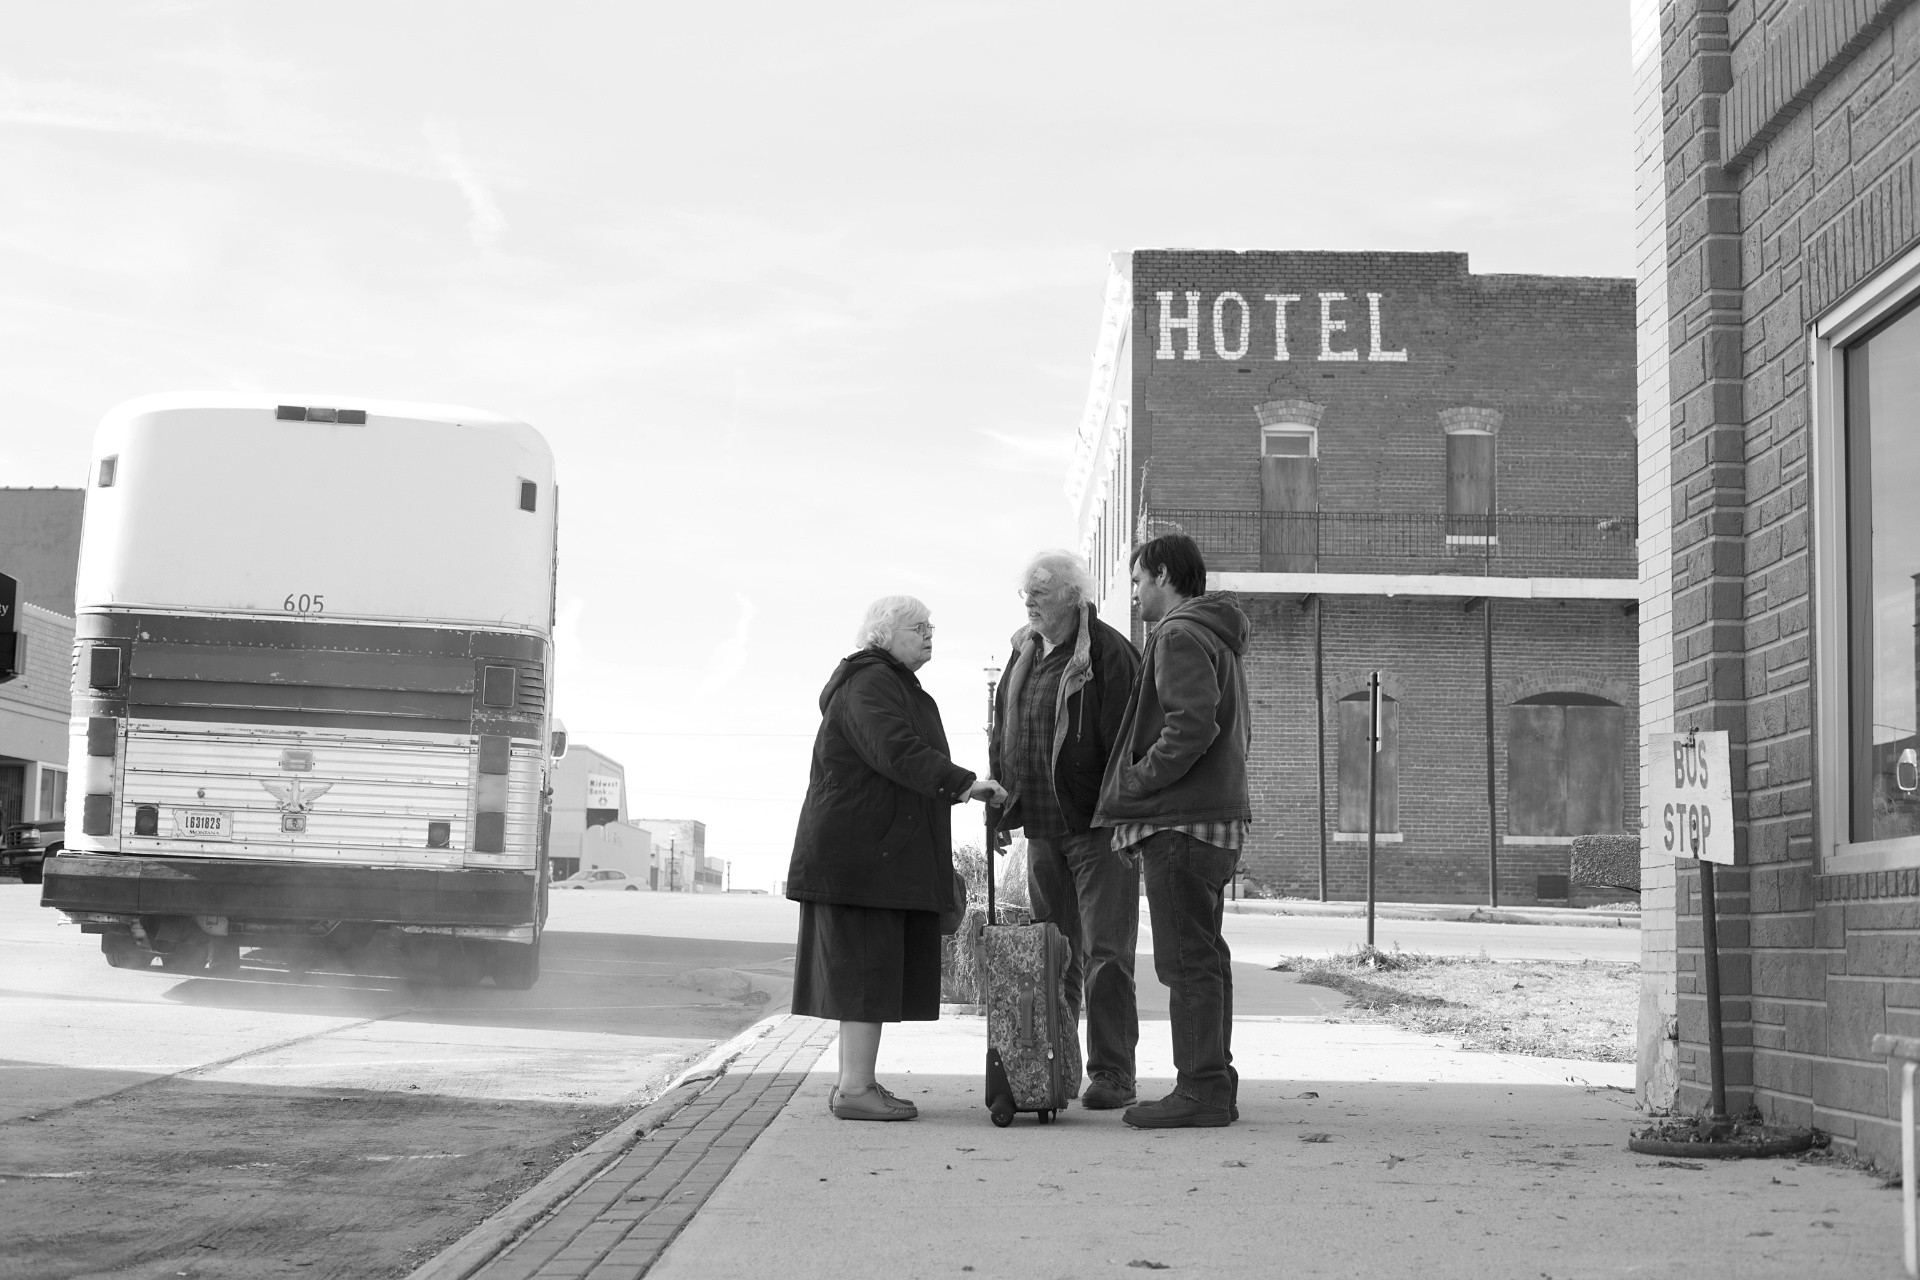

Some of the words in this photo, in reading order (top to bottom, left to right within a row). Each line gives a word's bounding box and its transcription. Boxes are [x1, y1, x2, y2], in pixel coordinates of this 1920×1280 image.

[1156, 290, 1408, 361] HOTEL
[283, 593, 324, 612] 605
[1673, 740, 1708, 789] BUS
[590, 787, 606, 795] Bank
[1663, 803, 1711, 855] STOP
